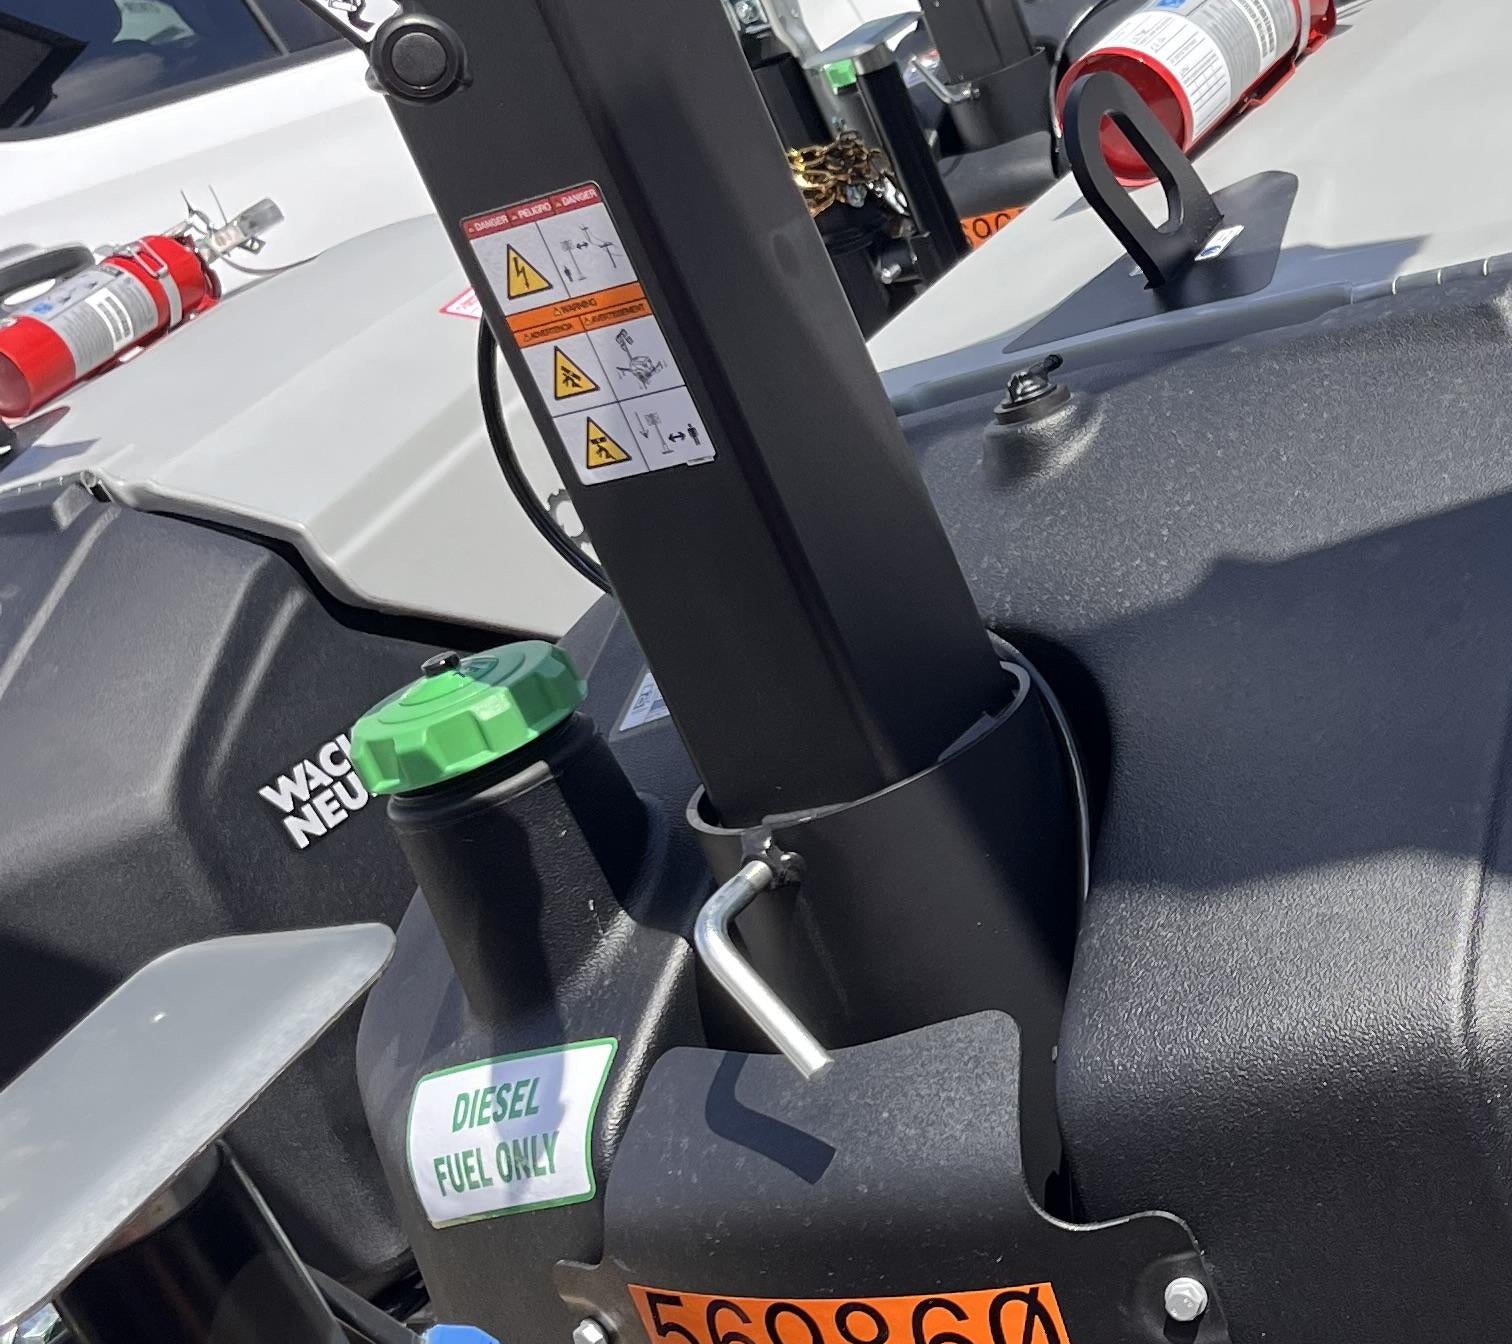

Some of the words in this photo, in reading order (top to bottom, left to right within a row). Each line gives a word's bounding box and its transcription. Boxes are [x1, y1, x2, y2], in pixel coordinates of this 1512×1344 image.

[474, 215, 509, 233] DANGER
[562, 187, 598, 207] DANGER
[452, 1077, 540, 1133] DIESEL
[433, 1147, 494, 1198] FUEL
[496, 1130, 560, 1184] ONLY
